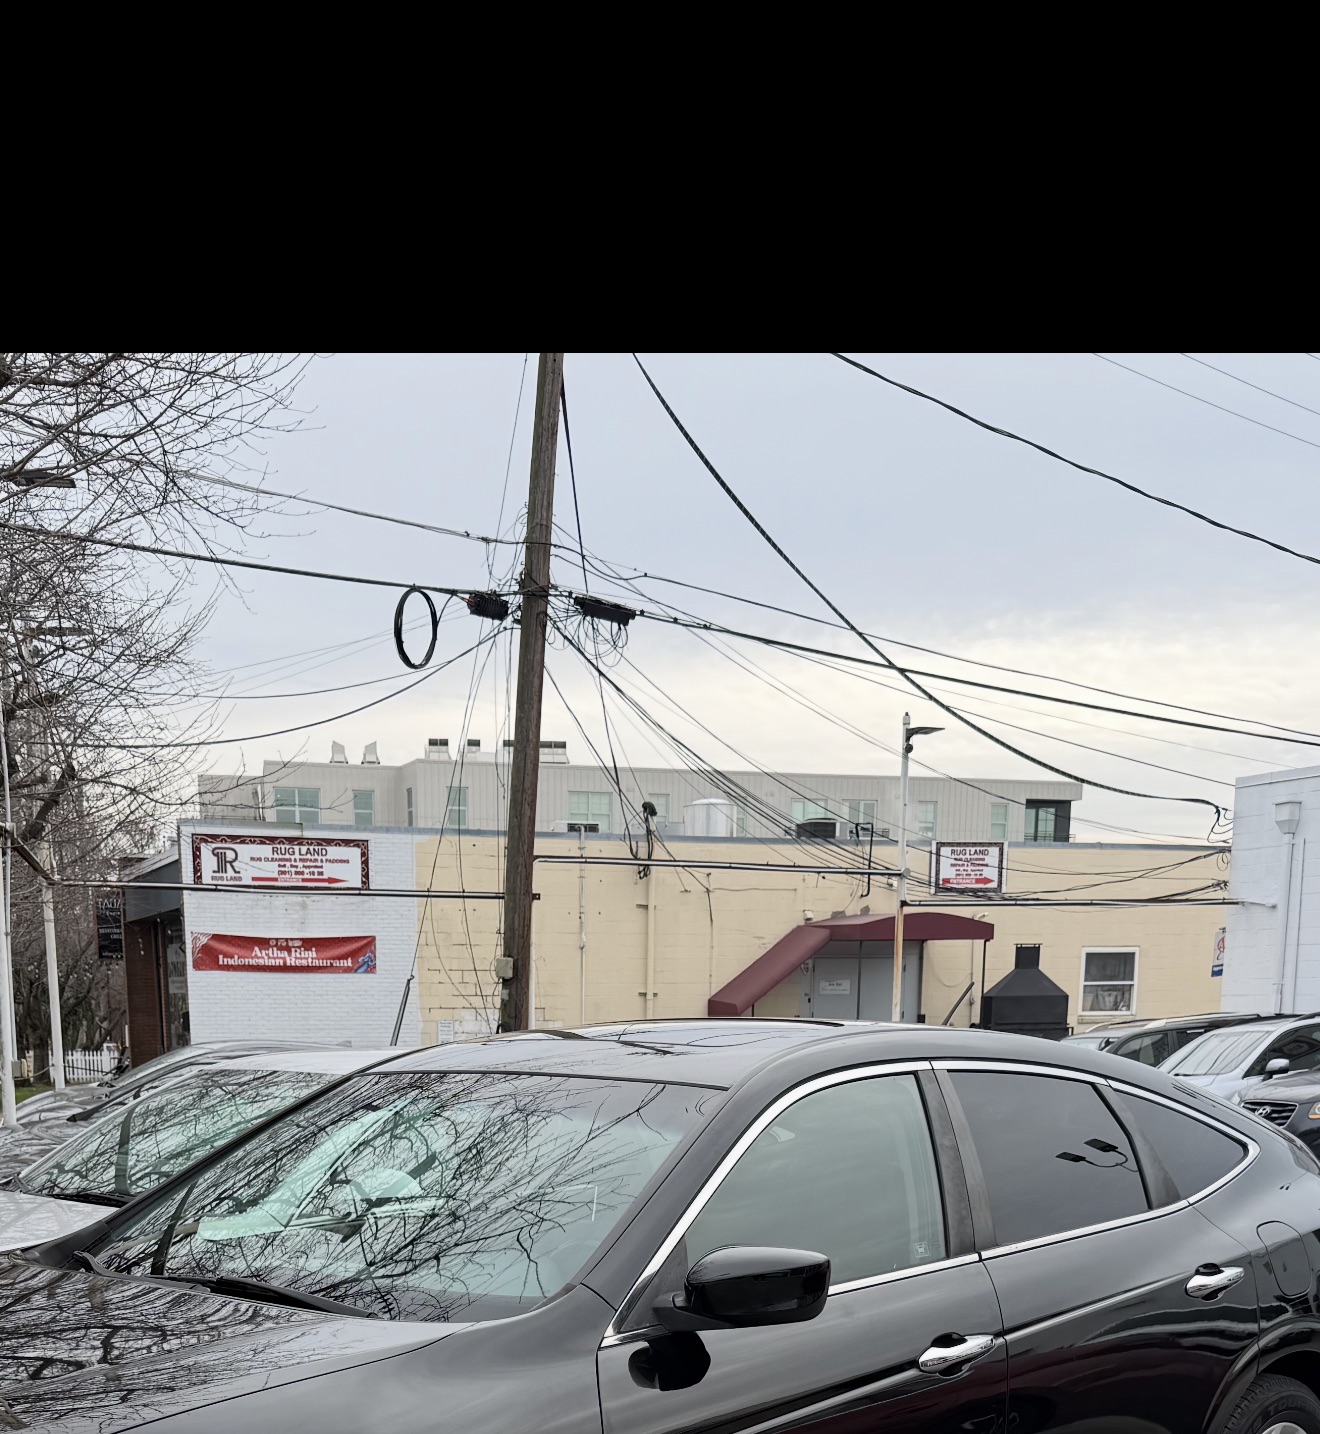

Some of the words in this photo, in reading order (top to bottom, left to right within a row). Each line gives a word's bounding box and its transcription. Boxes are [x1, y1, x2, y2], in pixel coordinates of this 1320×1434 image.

[272, 846, 295, 856] RUG
[298, 847, 328, 857] LAND
[251, 946, 288, 958] Artha
[291, 947, 317, 958] Rini
[218, 954, 284, 966] Indonesian
[286, 956, 353, 967] Restaurant
